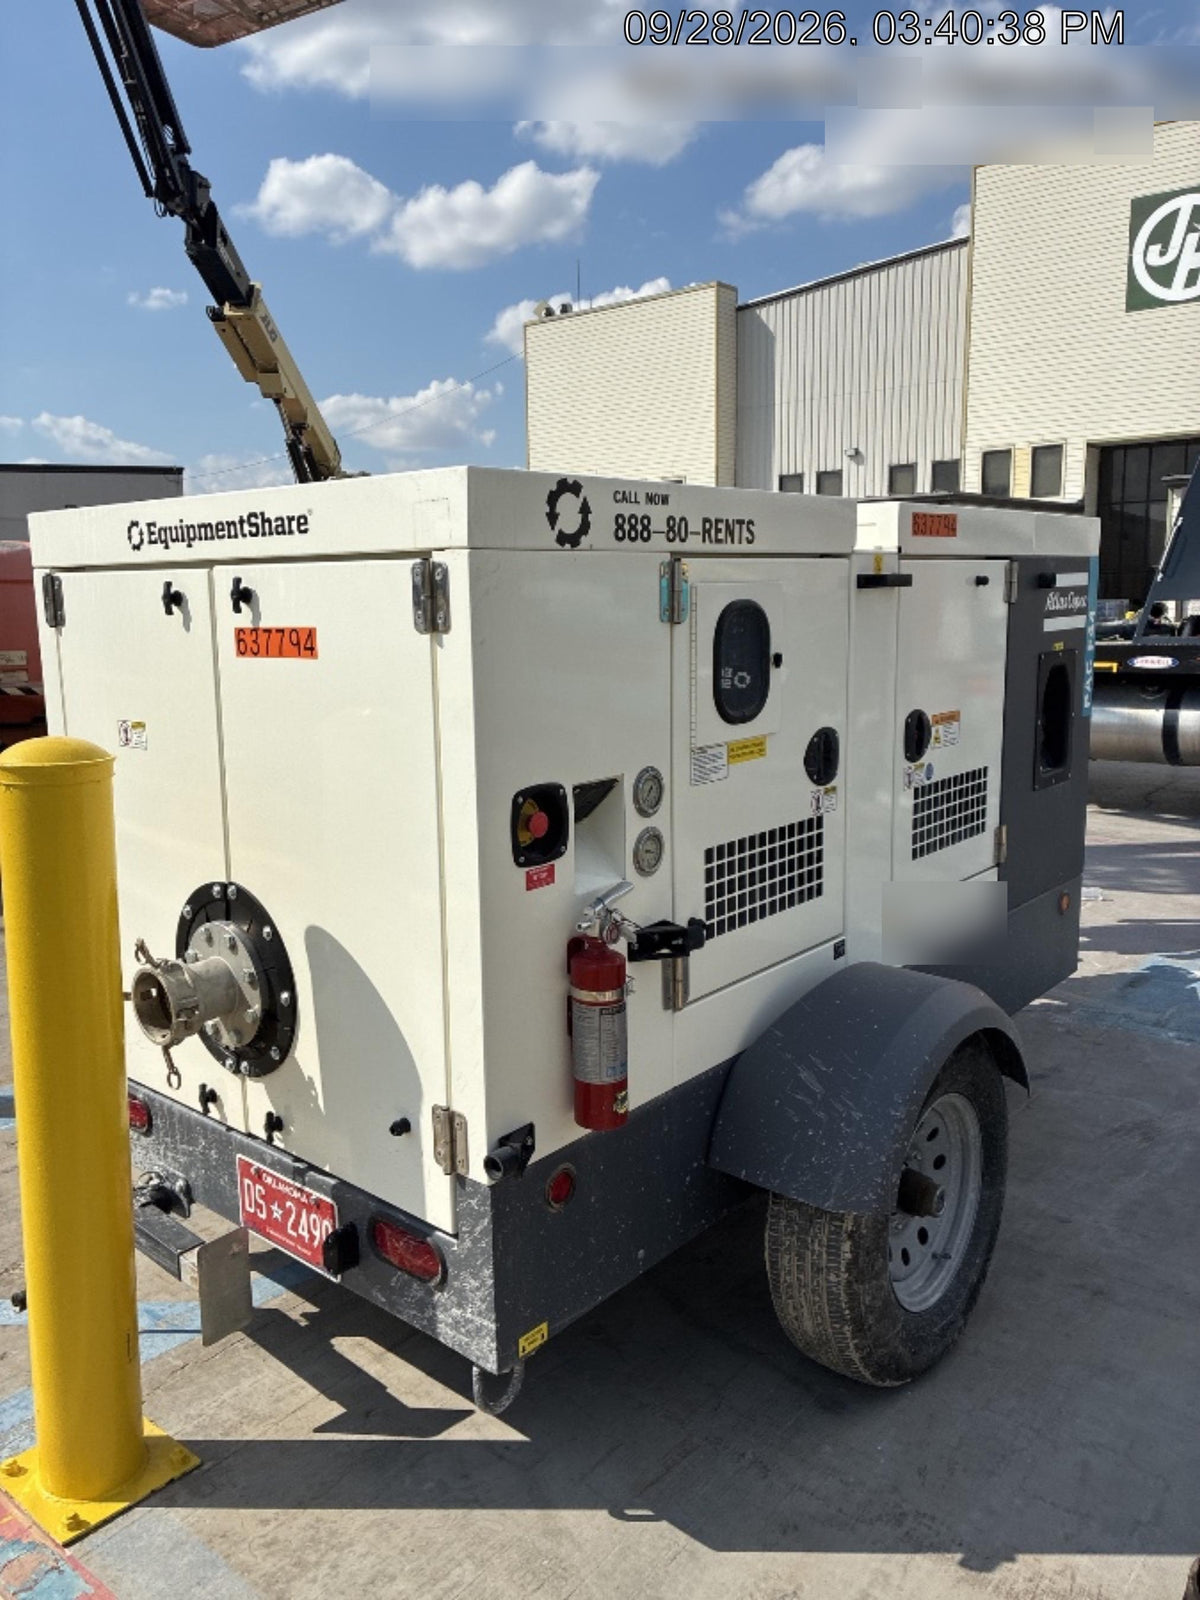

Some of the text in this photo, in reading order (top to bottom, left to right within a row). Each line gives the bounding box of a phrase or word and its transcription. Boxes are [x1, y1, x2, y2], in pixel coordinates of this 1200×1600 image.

[613, 490, 670, 506] CALL NOW
[146, 511, 309, 548] EquipmentShare
[614, 513, 755, 545] 888-80-RENTS
[912, 513, 957, 537] 637794
[236, 628, 316, 658] 637794
